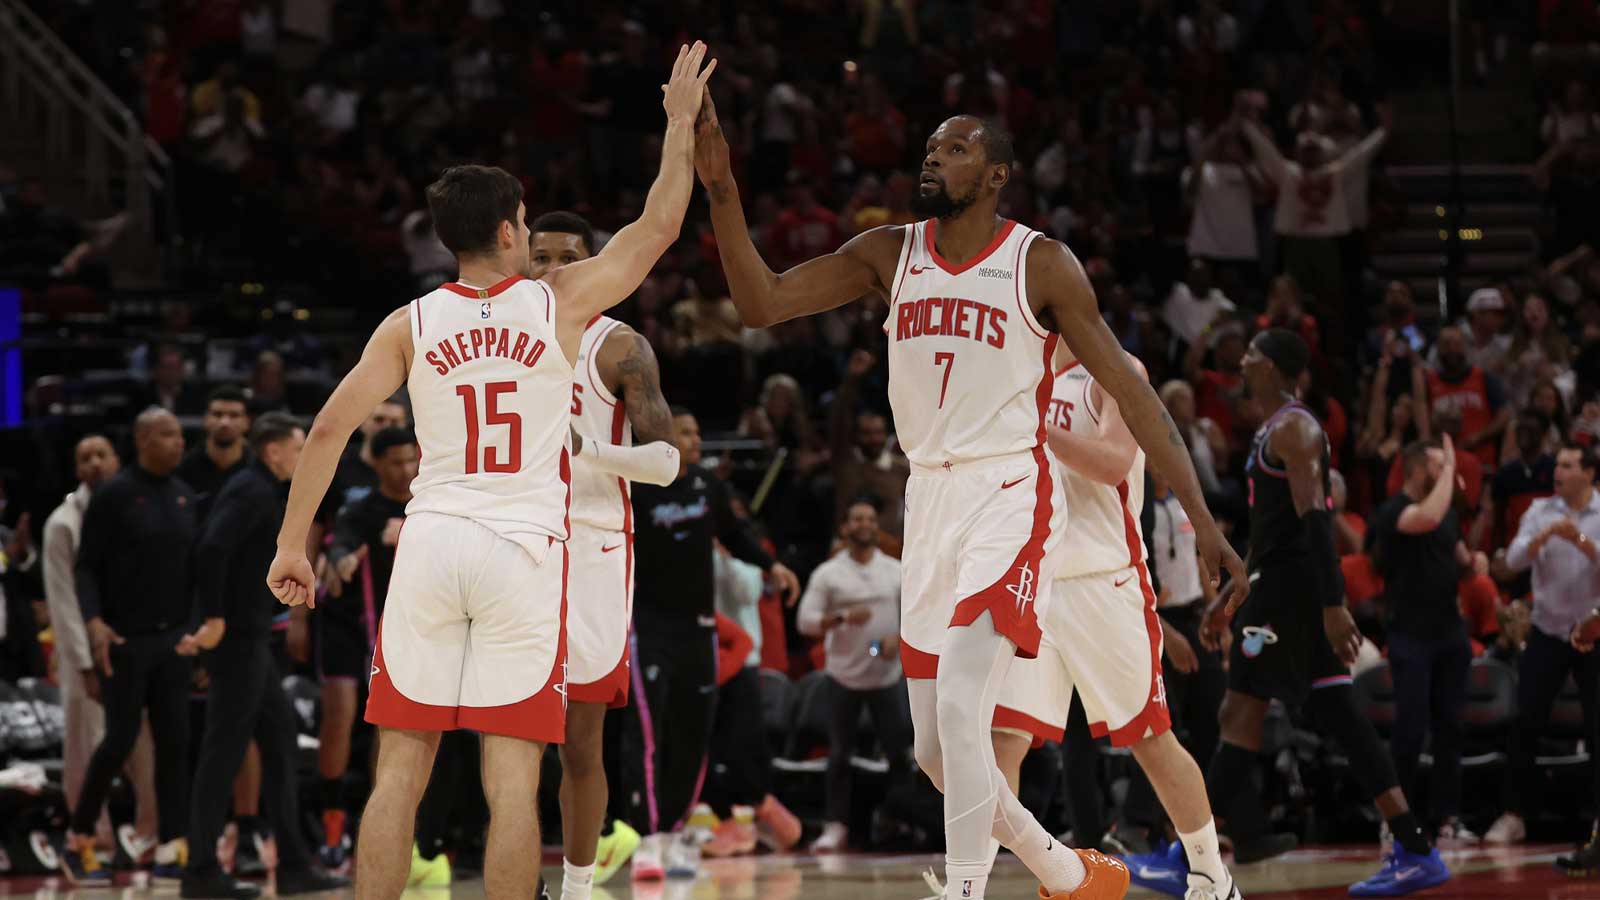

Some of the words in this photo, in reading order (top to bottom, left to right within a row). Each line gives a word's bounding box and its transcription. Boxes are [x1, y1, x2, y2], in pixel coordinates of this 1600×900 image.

[896, 297, 1008, 350] ROCKETS
[425, 327, 546, 376] SHEPPARD
[934, 352, 955, 410] 7
[456, 381, 522, 475] 15
